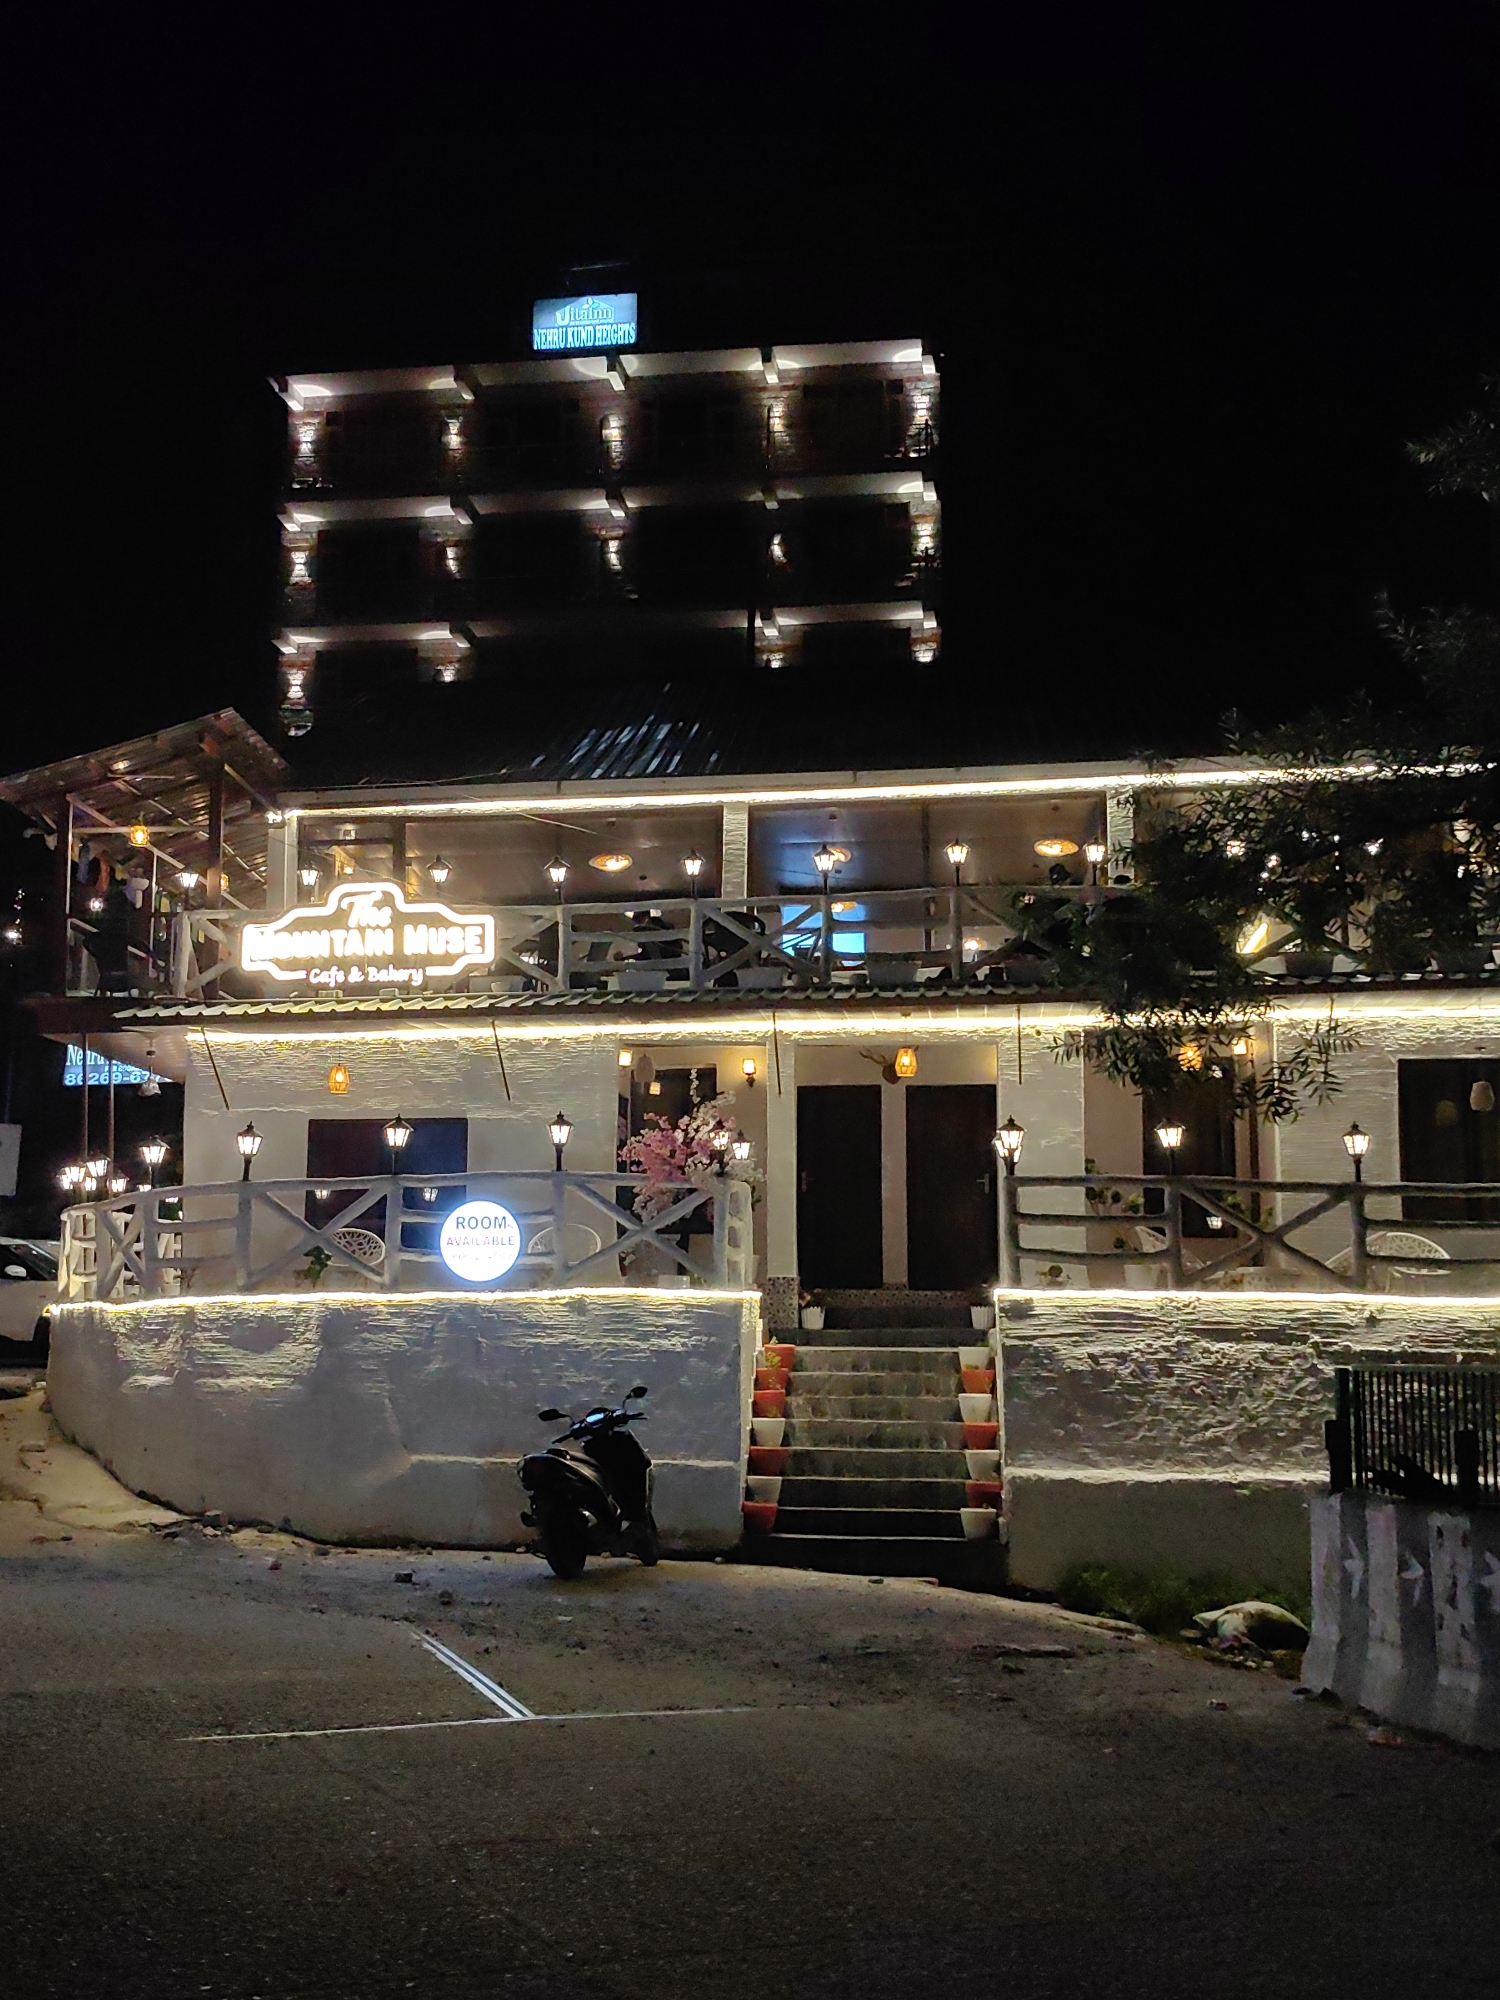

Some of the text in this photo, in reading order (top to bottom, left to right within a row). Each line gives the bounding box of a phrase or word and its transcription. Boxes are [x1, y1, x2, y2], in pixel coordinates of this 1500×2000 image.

[534, 323, 636, 350] NEHRU KUND HEIGHTS
[341, 890, 392, 927] The
[348, 966, 364, 982] &
[367, 964, 423, 986] Bakery
[446, 1236, 515, 1246] AVAILABLE
